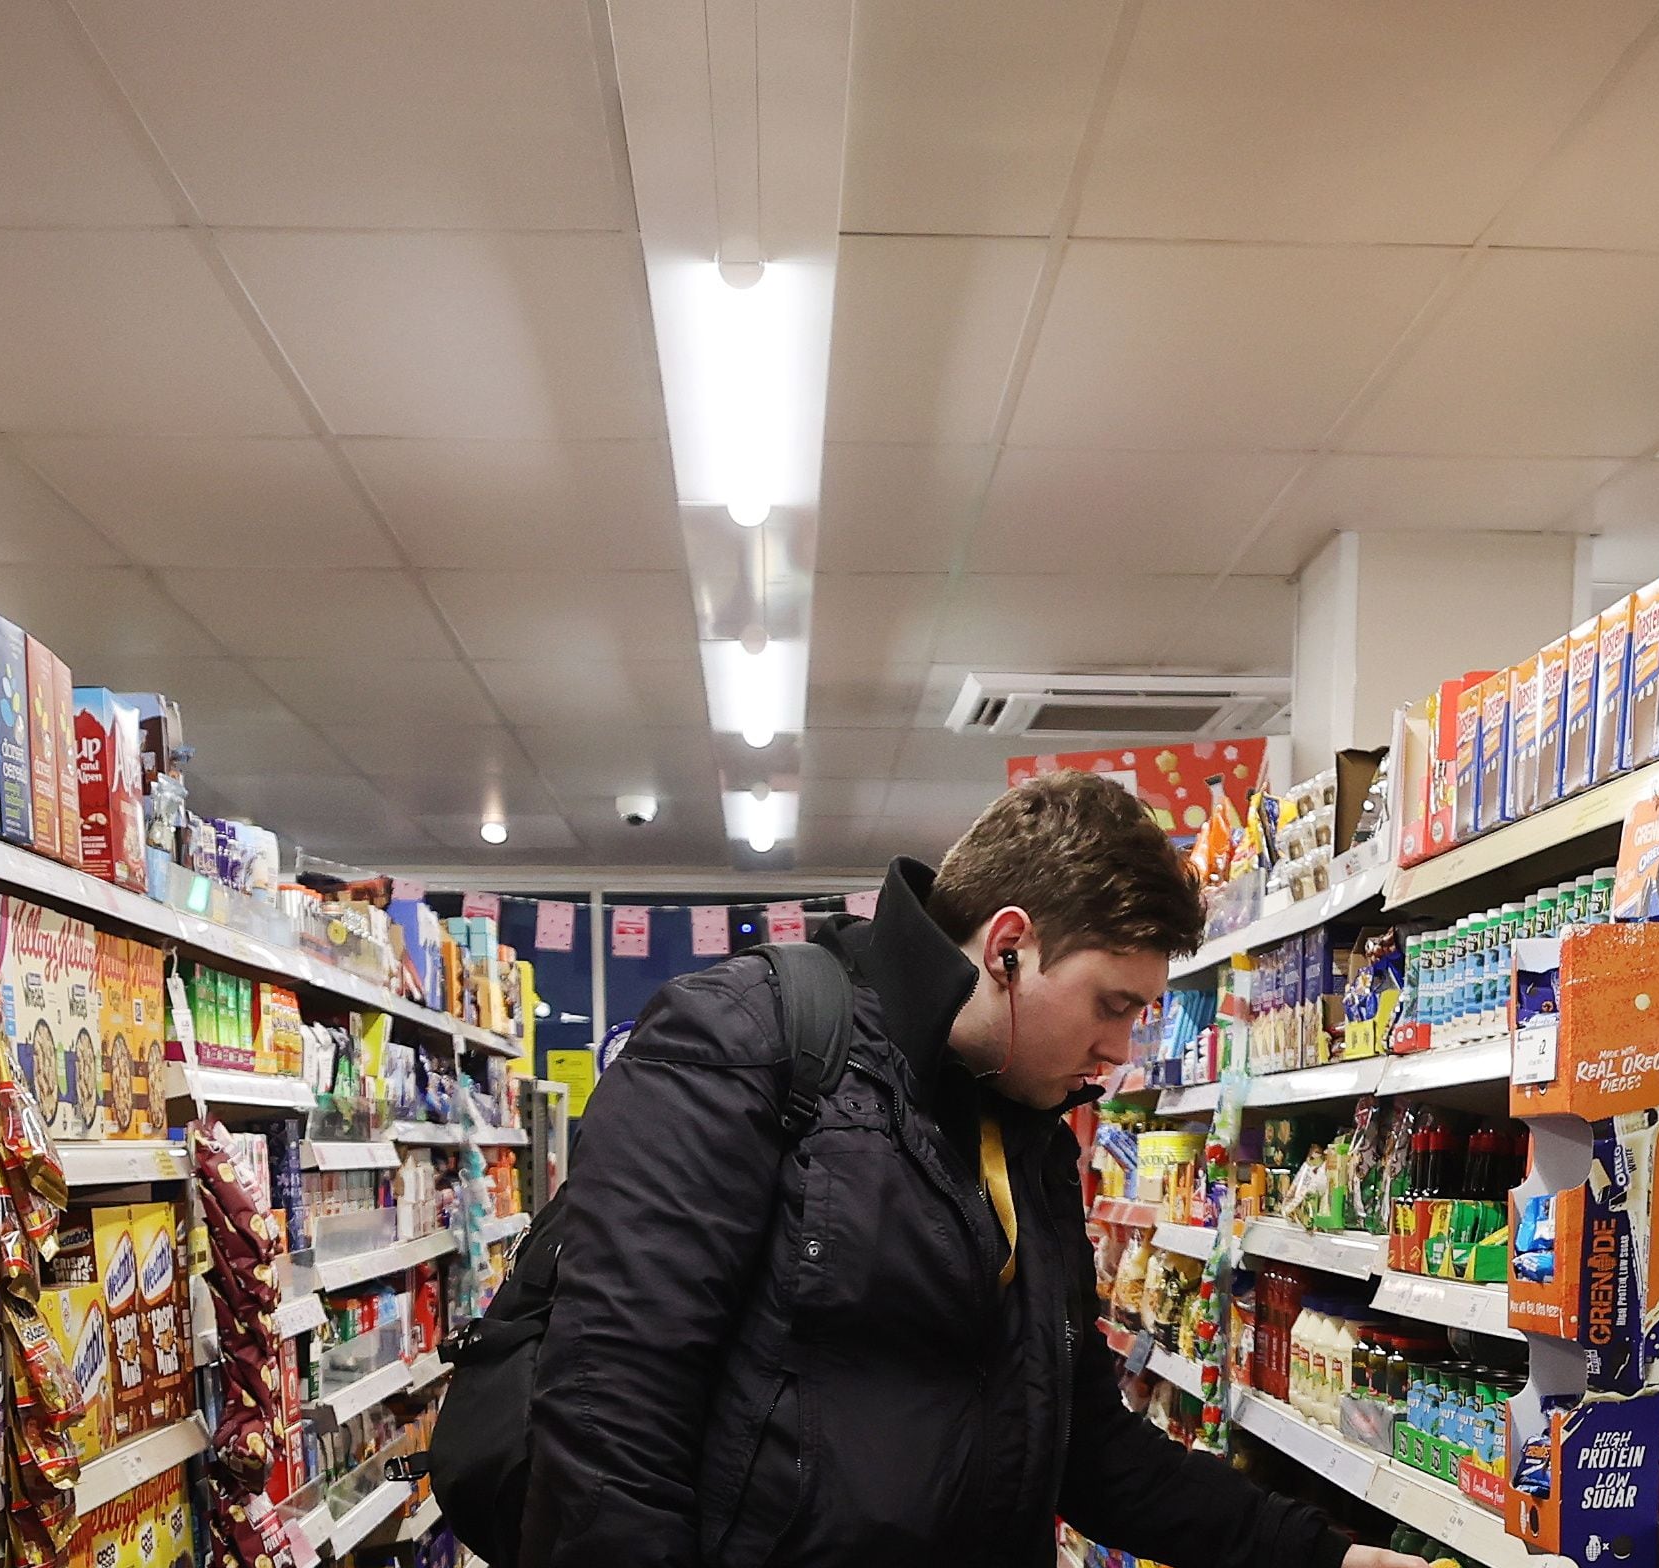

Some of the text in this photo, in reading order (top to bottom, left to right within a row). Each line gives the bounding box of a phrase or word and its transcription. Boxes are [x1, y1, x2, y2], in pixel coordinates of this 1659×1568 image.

[1575, 1060, 1620, 1083] REAL
[1599, 1075, 1642, 1095] PIECES
[1614, 1144, 1629, 1187] OREO
[1593, 1430, 1633, 1448] HIGH
[1577, 1444, 1646, 1470] PROTEIN
[1594, 1470, 1631, 1488] LOW
[1580, 1484, 1637, 1510] SUGAR
